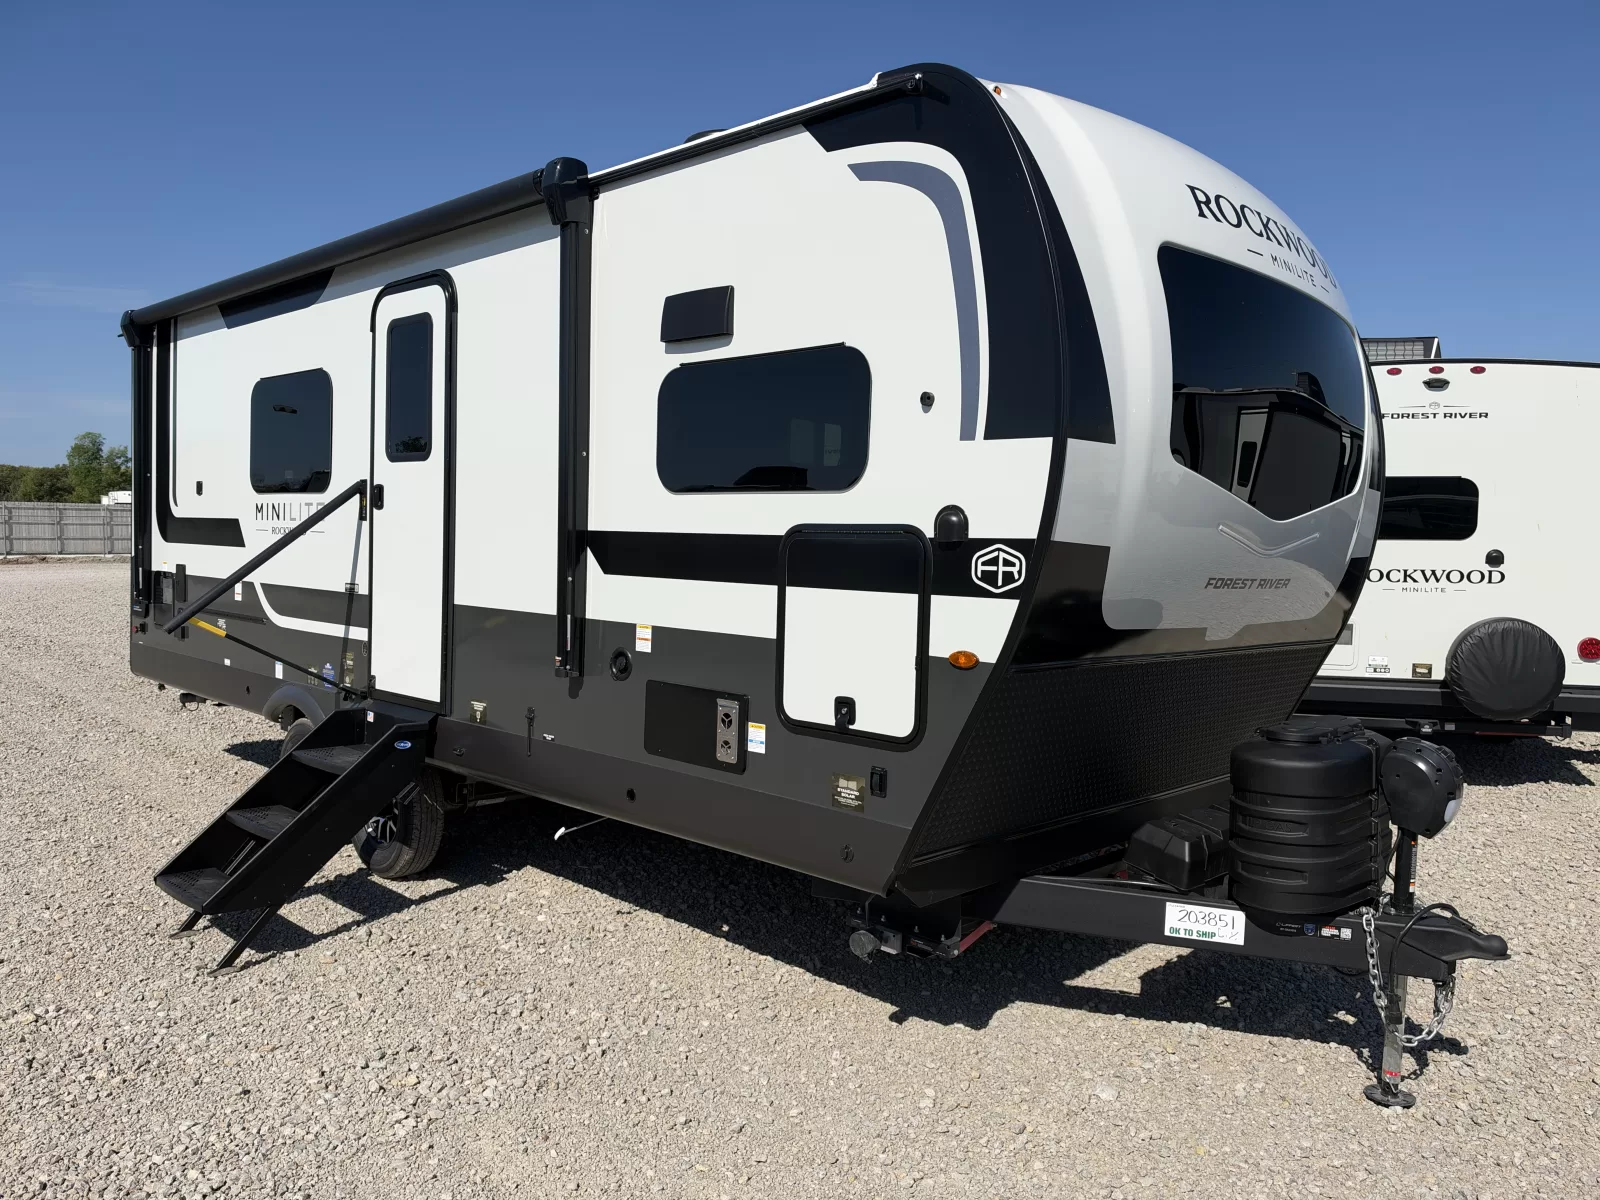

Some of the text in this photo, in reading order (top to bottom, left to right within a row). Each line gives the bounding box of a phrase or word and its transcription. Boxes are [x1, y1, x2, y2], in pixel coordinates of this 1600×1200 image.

[1270, 253, 1317, 287] MINILITE
[1381, 412, 1440, 420] FOREST
[1366, 568, 1506, 584] OCKWOOD
[1204, 577, 1291, 590] FOREST RIVER
[1177, 909, 1235, 930] 203851
[1169, 926, 1217, 939] OK TO SHIP
